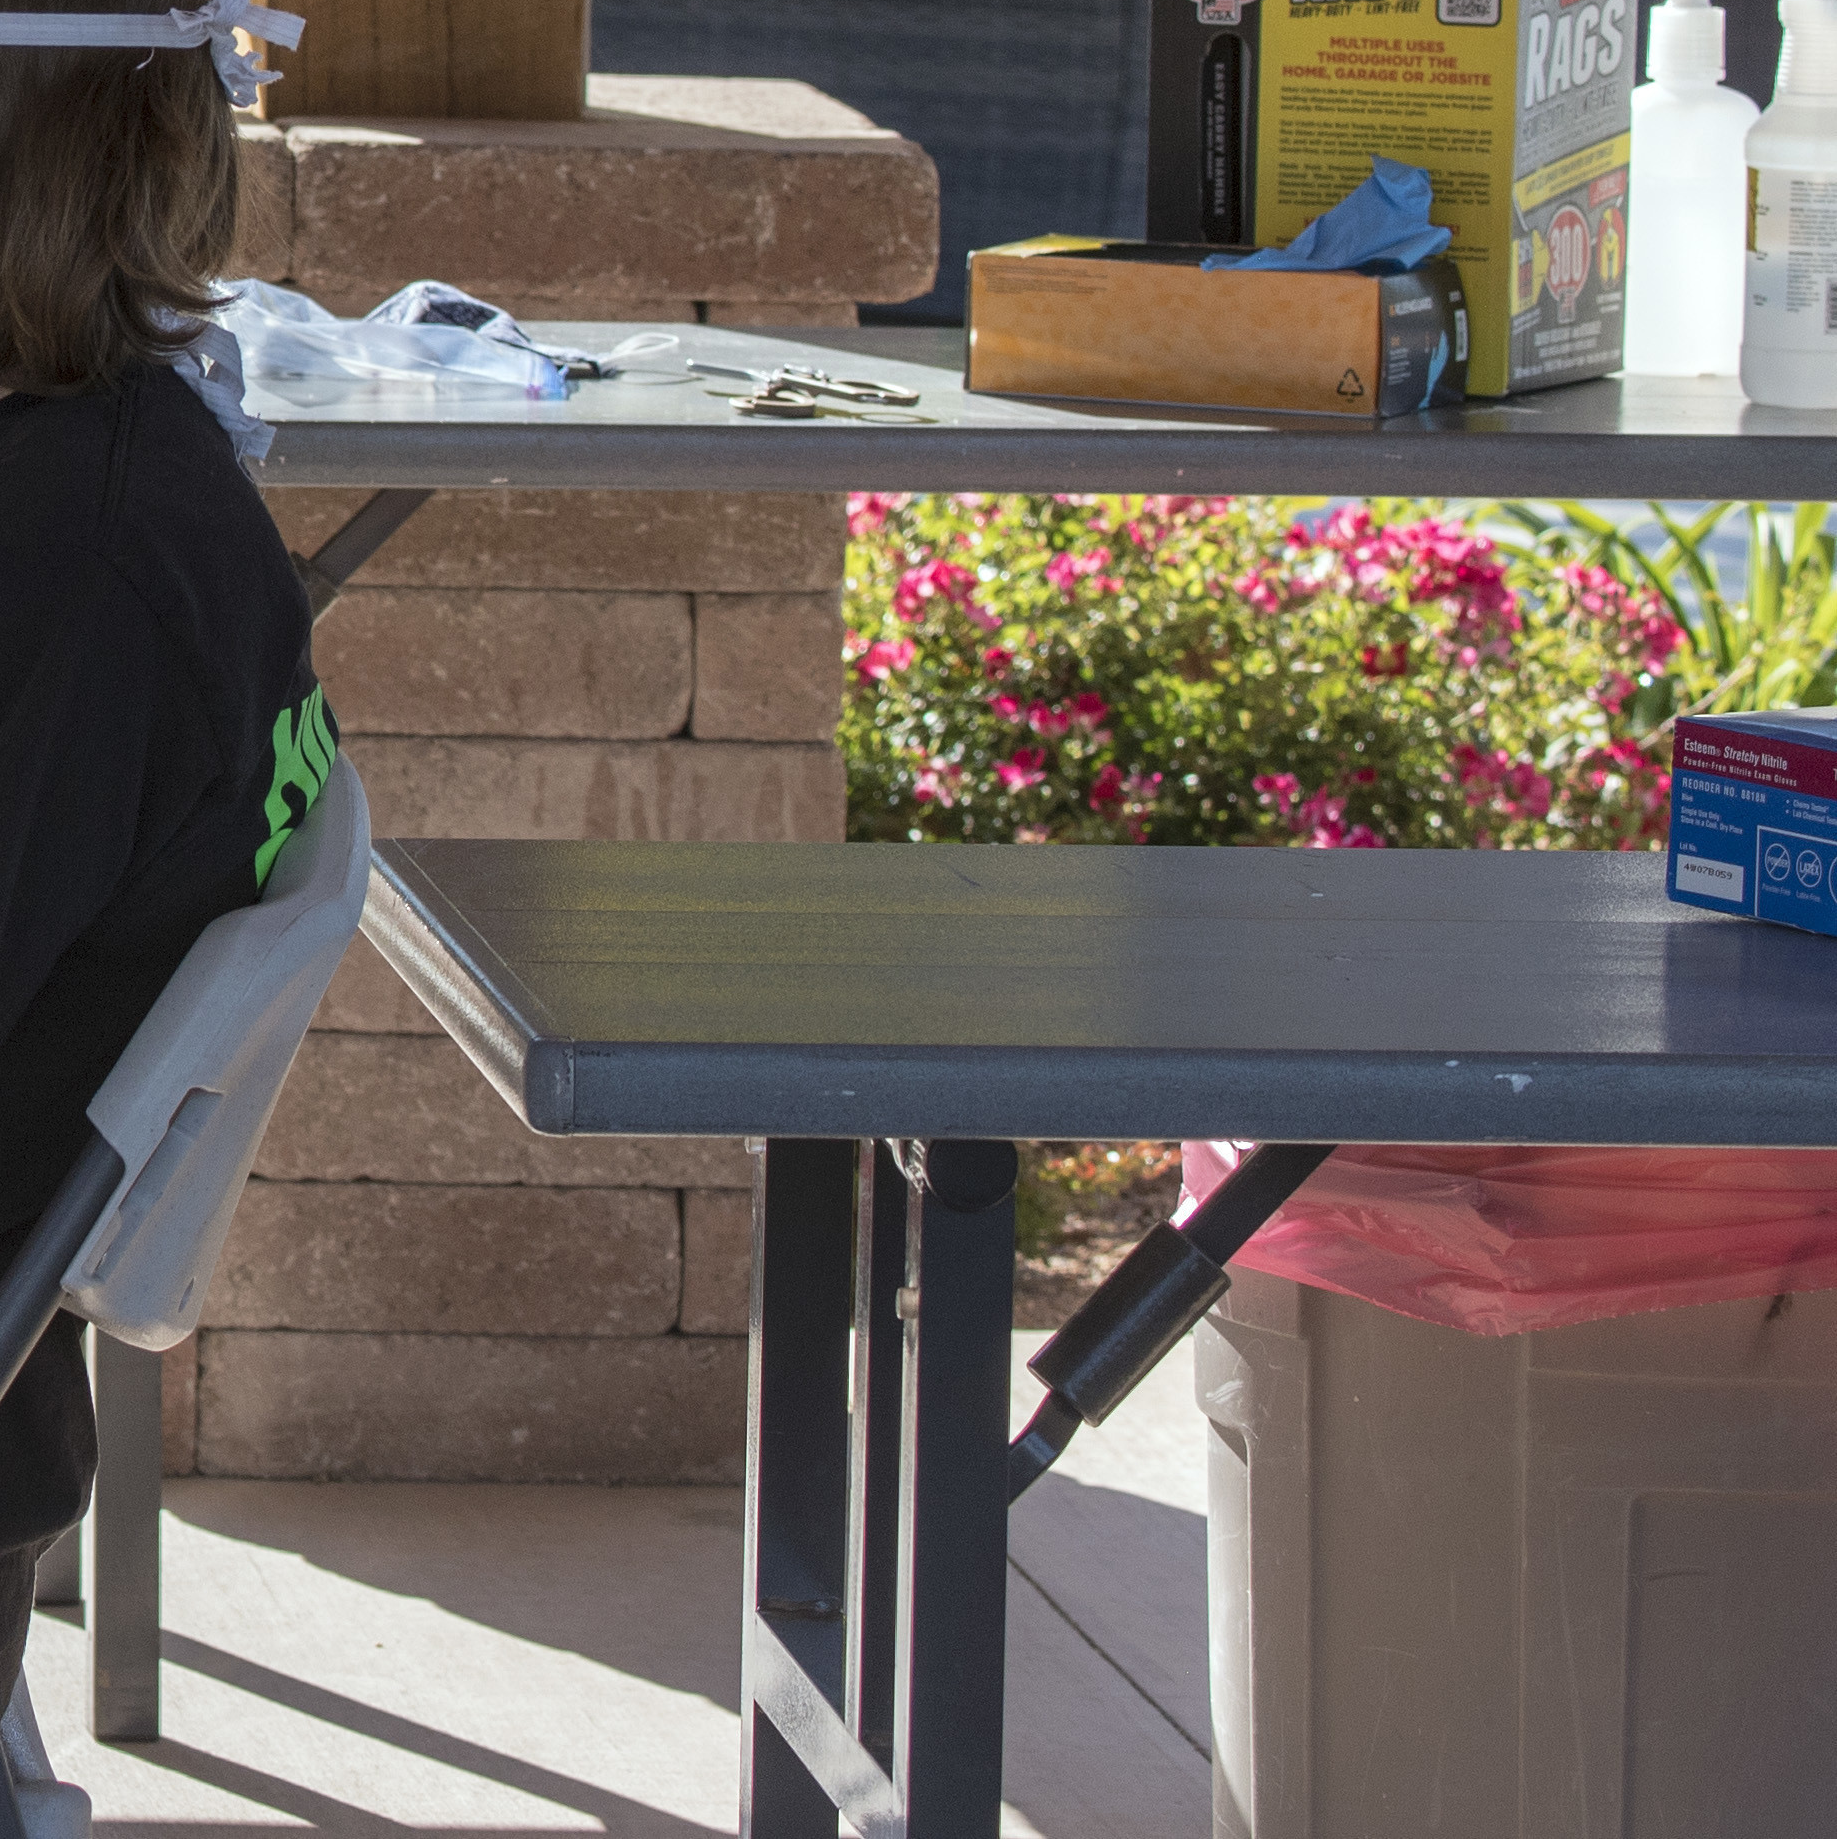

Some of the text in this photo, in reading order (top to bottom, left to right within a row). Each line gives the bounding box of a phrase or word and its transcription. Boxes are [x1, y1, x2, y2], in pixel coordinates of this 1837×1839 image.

[1329, 36, 1445, 54] MULTIPLE USES
[1317, 51, 1458, 69] THROUGHOUT THE
[1214, 63, 1225, 101] EASY
[1282, 65, 1492, 87] HOME, GARAGE OR JOBSITE
[1214, 103, 1225, 152] CARRY
[1723, 746, 1760, 766] Stretchy
[1761, 753, 1788, 771] Nitrile
[1682, 756, 1797, 787] Powder-Free Nitrile Exam Gloves
[1682, 777, 1721, 794] REORDER
[1723, 784, 1738, 798] NO.
